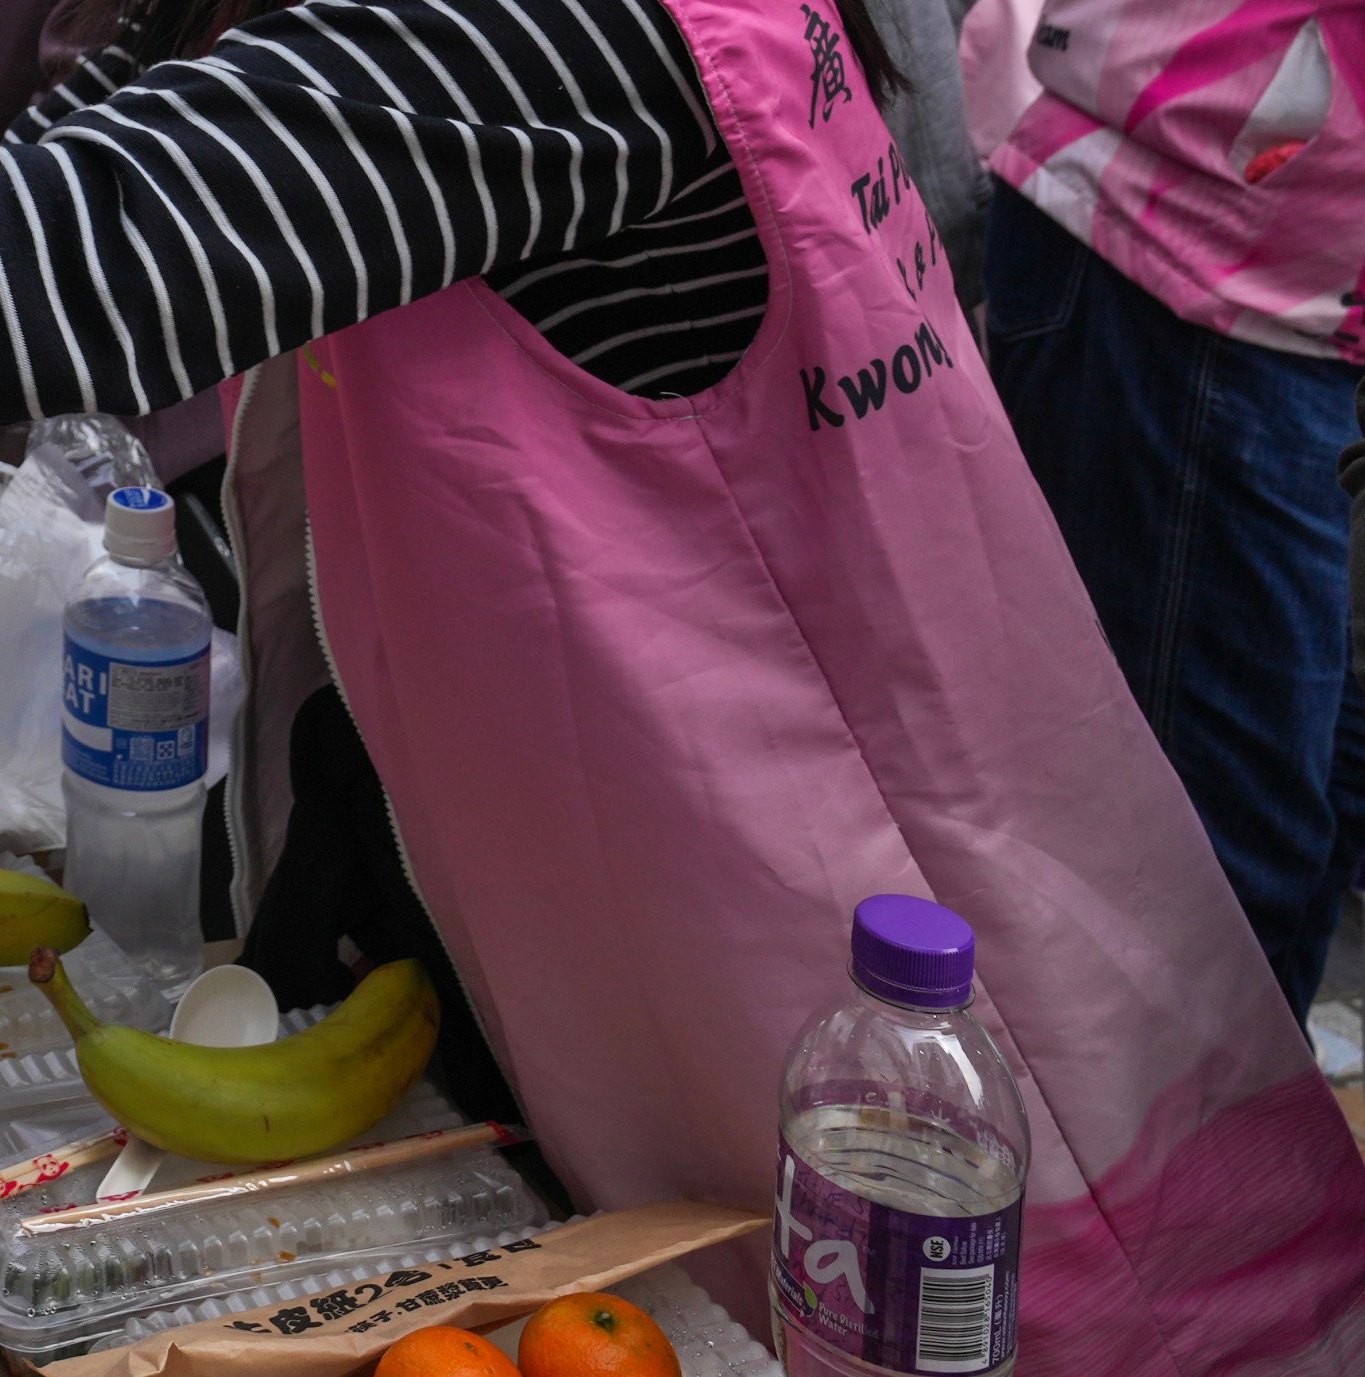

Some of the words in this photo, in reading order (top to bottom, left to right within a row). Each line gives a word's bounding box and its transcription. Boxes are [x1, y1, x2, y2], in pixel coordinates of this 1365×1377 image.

[799, 3, 853, 130] 廣
[851, 156, 890, 235] Tai
[817, 1310, 849, 1337] Water
[818, 1300, 839, 1321] Pure
